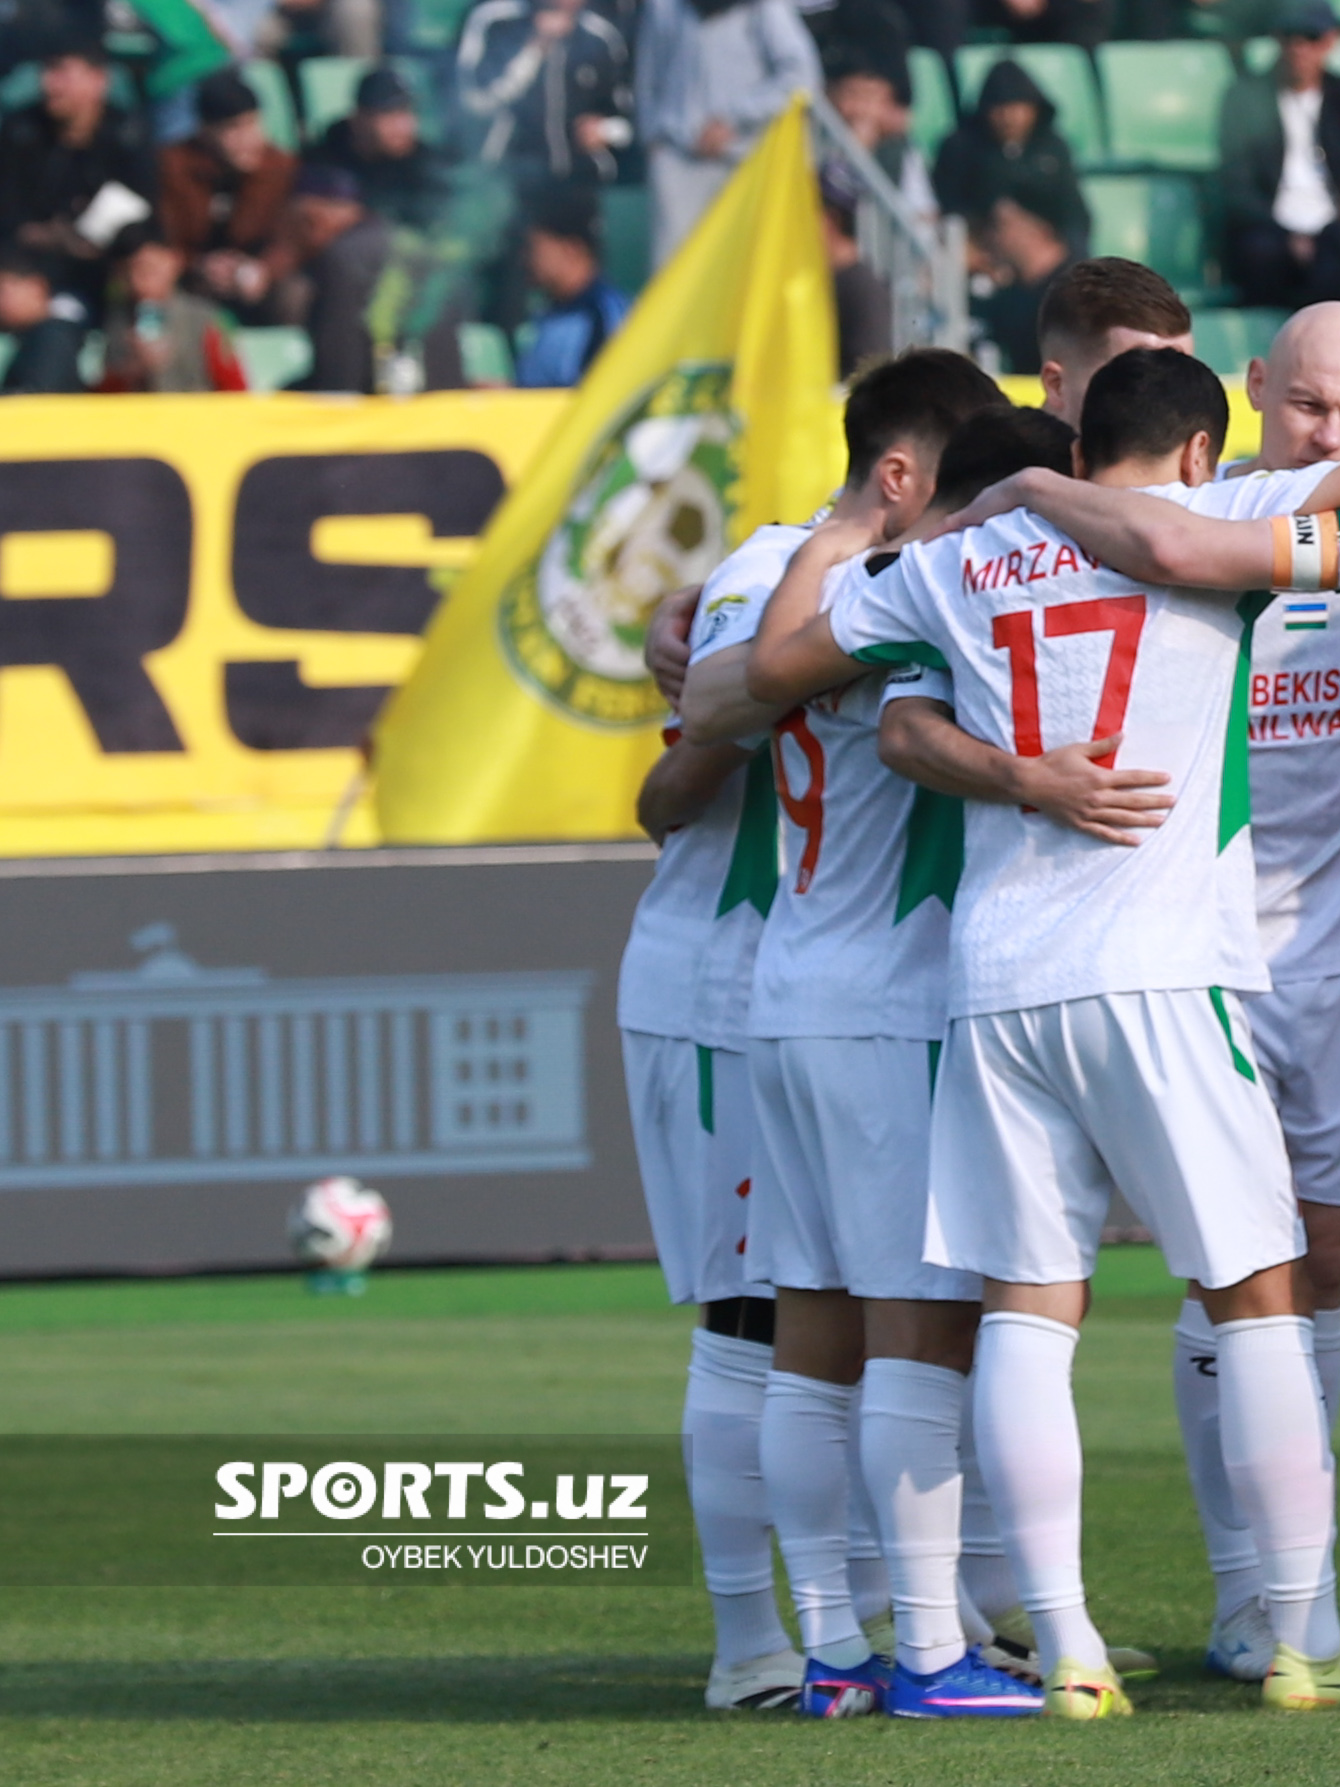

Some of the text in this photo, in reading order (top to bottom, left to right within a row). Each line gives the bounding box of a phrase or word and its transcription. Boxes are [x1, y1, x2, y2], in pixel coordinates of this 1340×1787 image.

[963, 541, 1099, 595] MIRZA
[992, 595, 1146, 813] 17
[774, 707, 825, 894] 9
